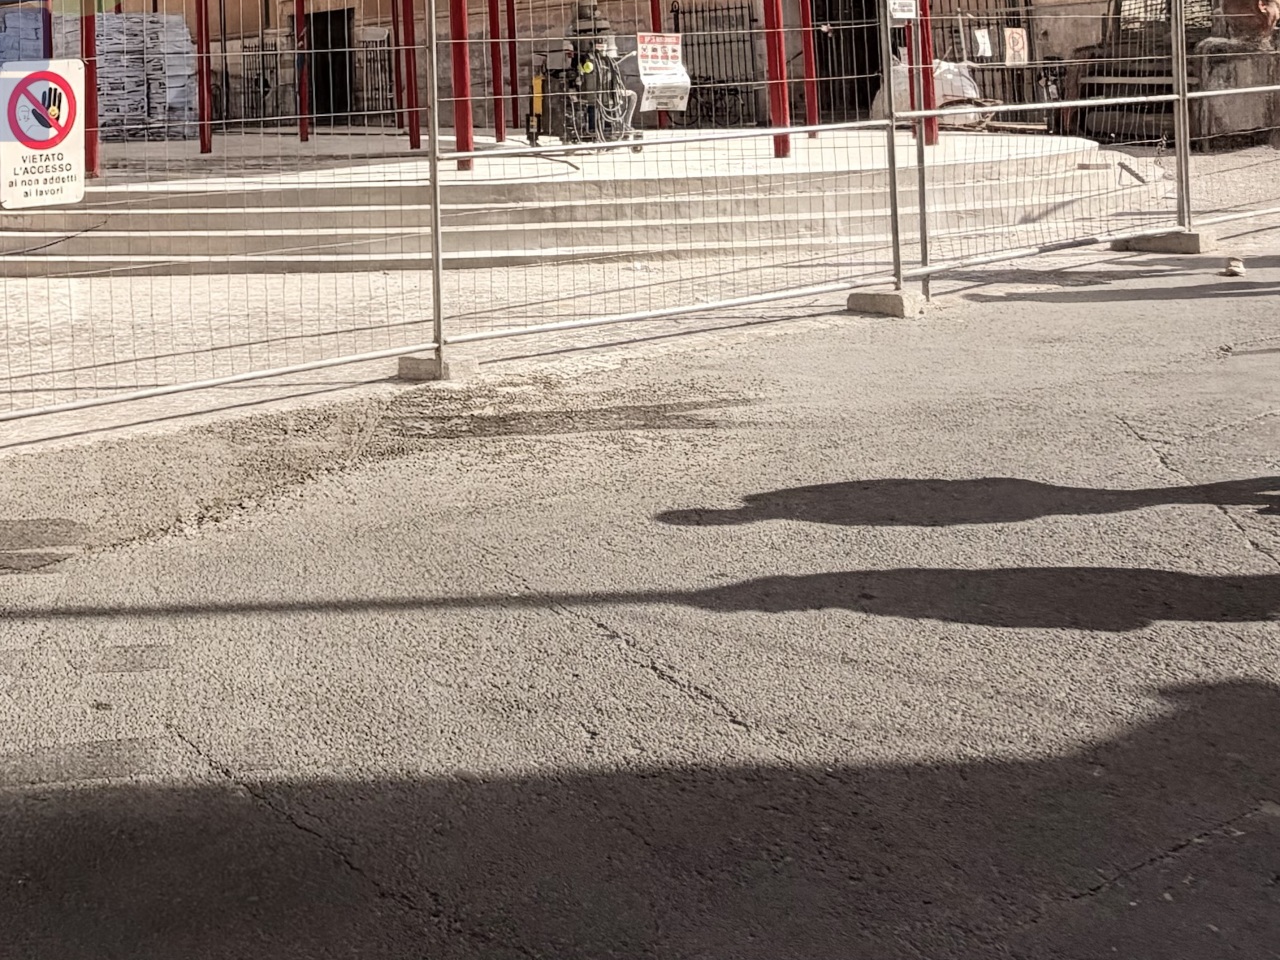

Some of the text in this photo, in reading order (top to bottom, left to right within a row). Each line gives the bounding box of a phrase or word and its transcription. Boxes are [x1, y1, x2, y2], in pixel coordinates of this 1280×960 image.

[22, 153, 64, 163] VIETATO
[14, 163, 72, 176] L'ACCESSO
[9, 175, 77, 188] ai non addetti
[23, 187, 64, 198] ai lavori
